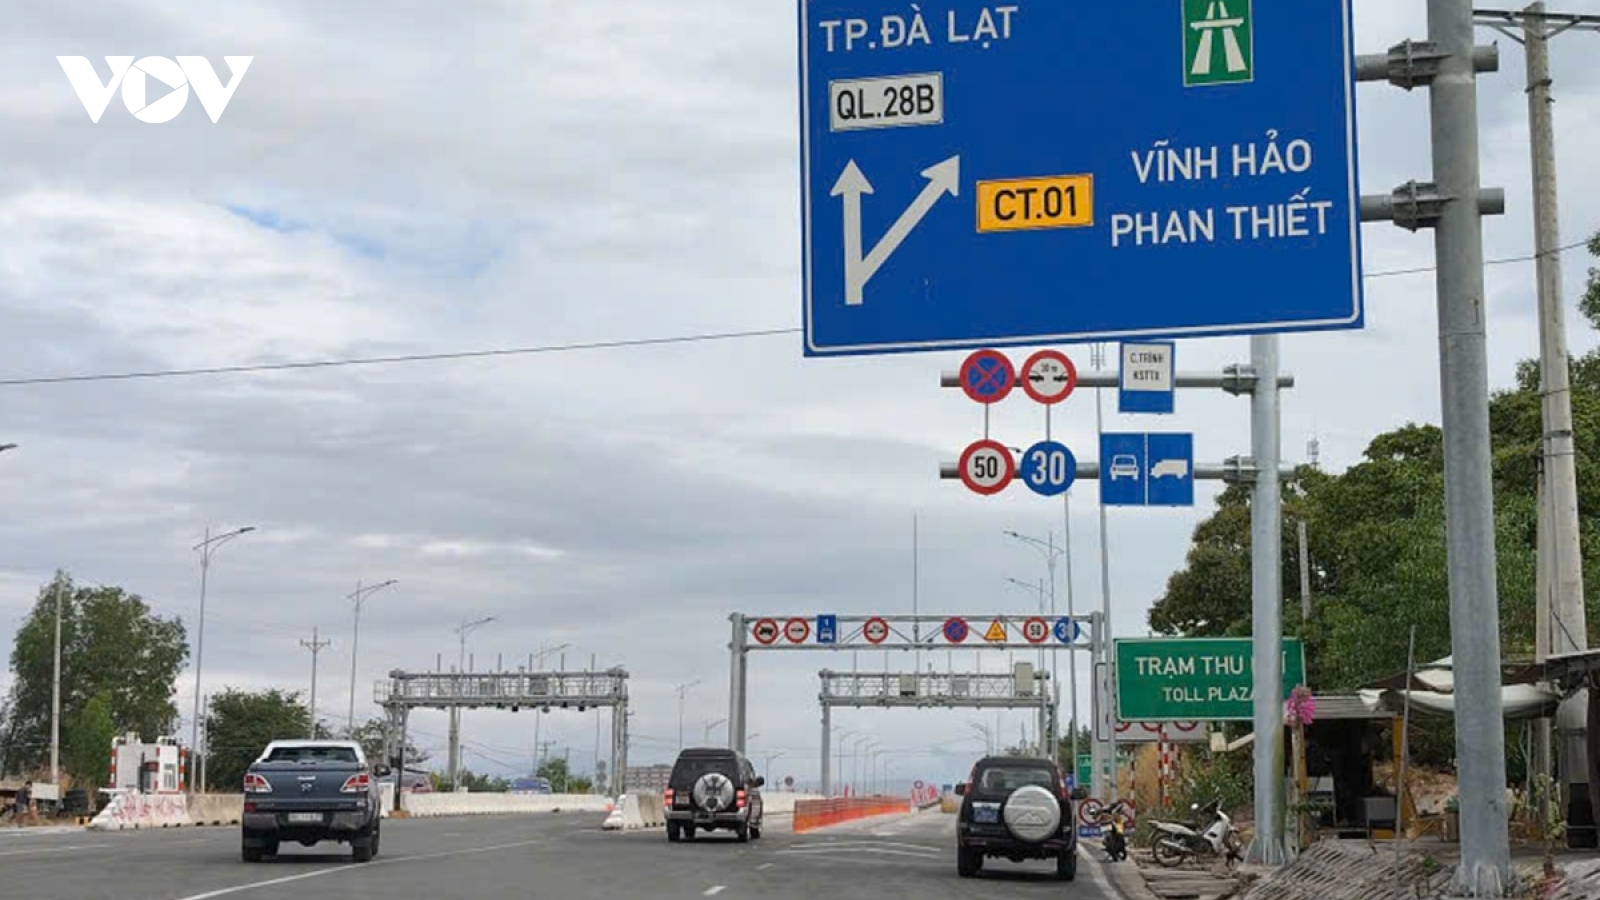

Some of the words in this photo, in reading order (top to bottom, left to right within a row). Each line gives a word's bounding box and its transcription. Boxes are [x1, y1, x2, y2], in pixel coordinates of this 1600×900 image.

[819, 3, 931, 52] TP.ĐÀ
[948, 6, 1019, 49] LẠT
[837, 83, 935, 120] QL.28B
[1131, 139, 1218, 184] VĨNH
[1232, 129, 1312, 177] HẢO
[994, 186, 1078, 222] CT.01
[1111, 208, 1215, 248] PHAN
[1226, 187, 1333, 240] THIẾT
[974, 455, 998, 479] 50
[1031, 450, 1066, 486] 30
[1135, 656, 1195, 680] TRẠM
[1200, 655, 1244, 676] THU
[1163, 686, 1205, 702] TOLL
